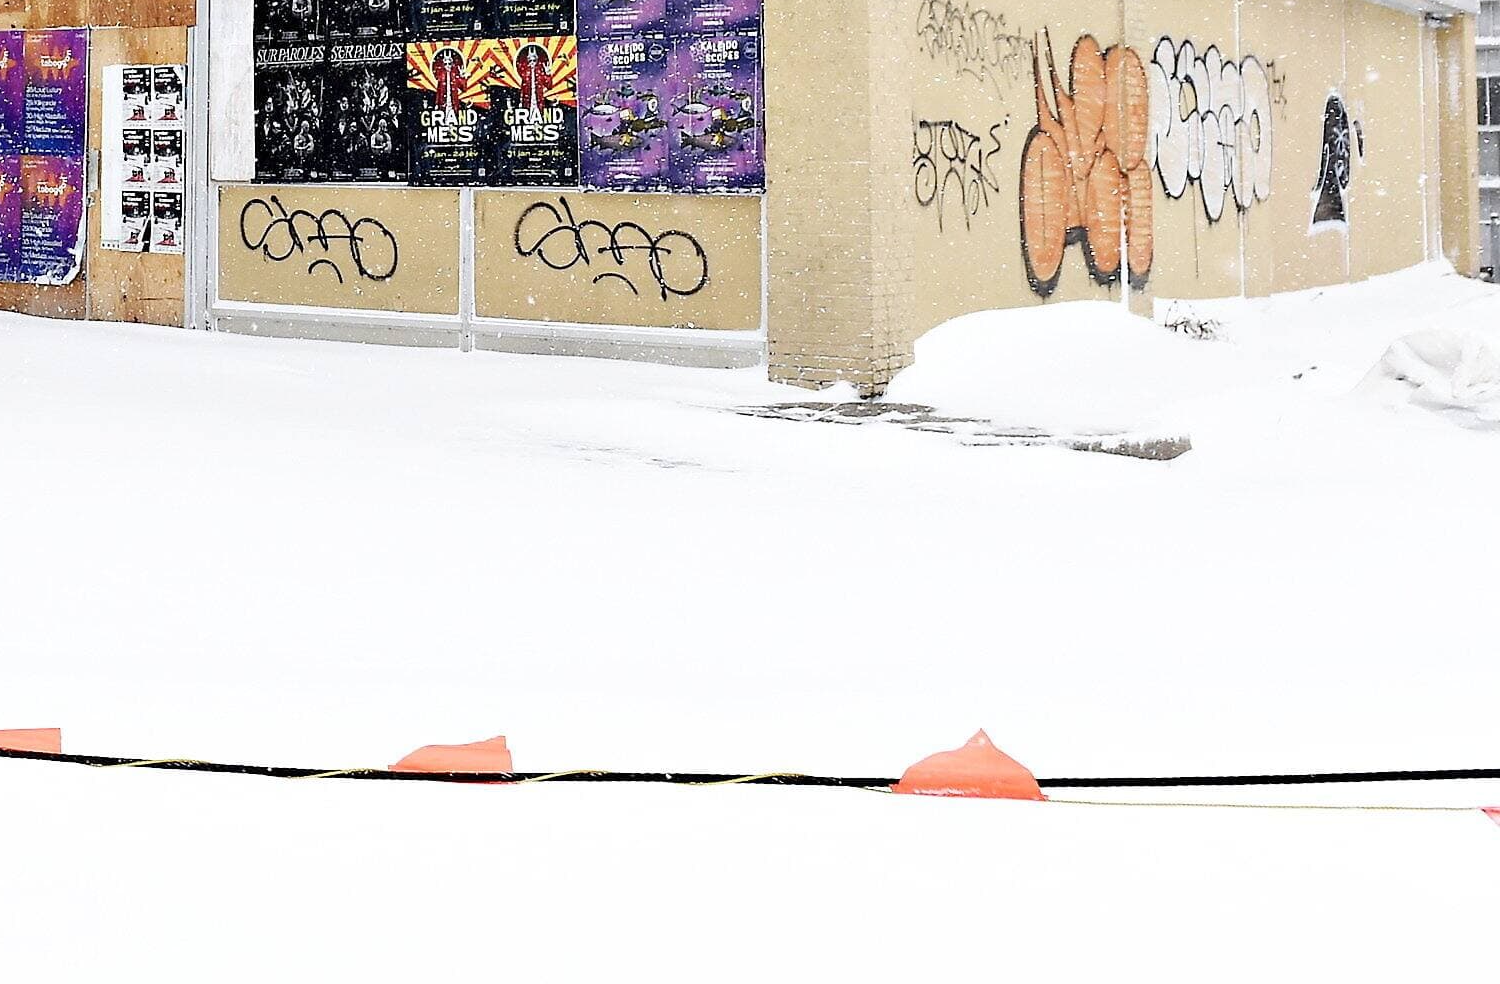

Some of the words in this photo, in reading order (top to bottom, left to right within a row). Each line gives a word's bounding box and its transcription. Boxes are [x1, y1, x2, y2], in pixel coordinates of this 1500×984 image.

[608, 42, 645, 55] KALEIDO
[700, 40, 738, 54] KALEIDO
[612, 52, 646, 65] SCOPES
[705, 50, 740, 63] SCOPES
[421, 109, 478, 127] GRAND
[504, 107, 564, 126] GRAND
